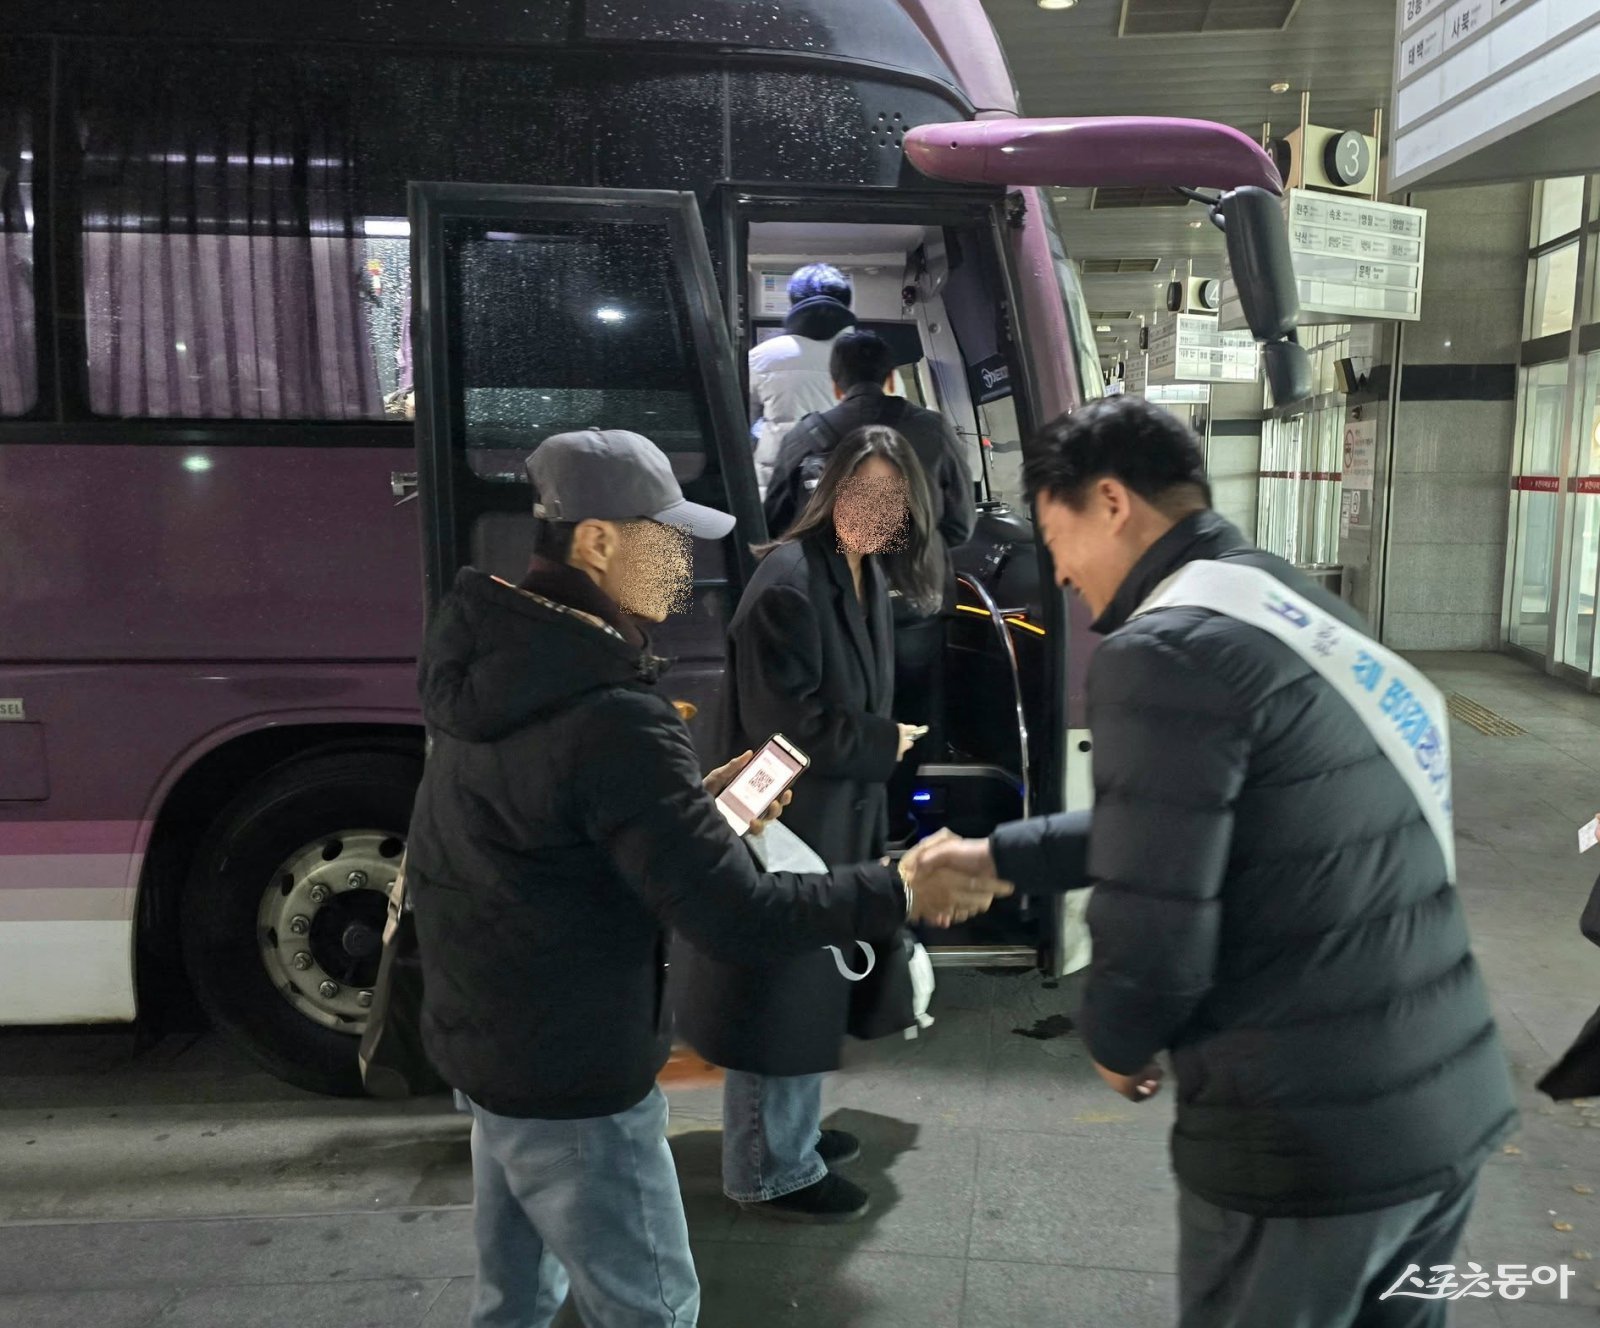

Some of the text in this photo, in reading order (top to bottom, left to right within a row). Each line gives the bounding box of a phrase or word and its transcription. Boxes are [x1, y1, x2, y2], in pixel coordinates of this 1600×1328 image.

[1451, 10, 1470, 38] 사북
[1408, 39, 1424, 65] 태백
[1345, 139, 1360, 177] 3
[1329, 208, 1341, 220] 속초
[1209, 283, 1219, 304] 4
[0, 703, 20, 714] SEL
